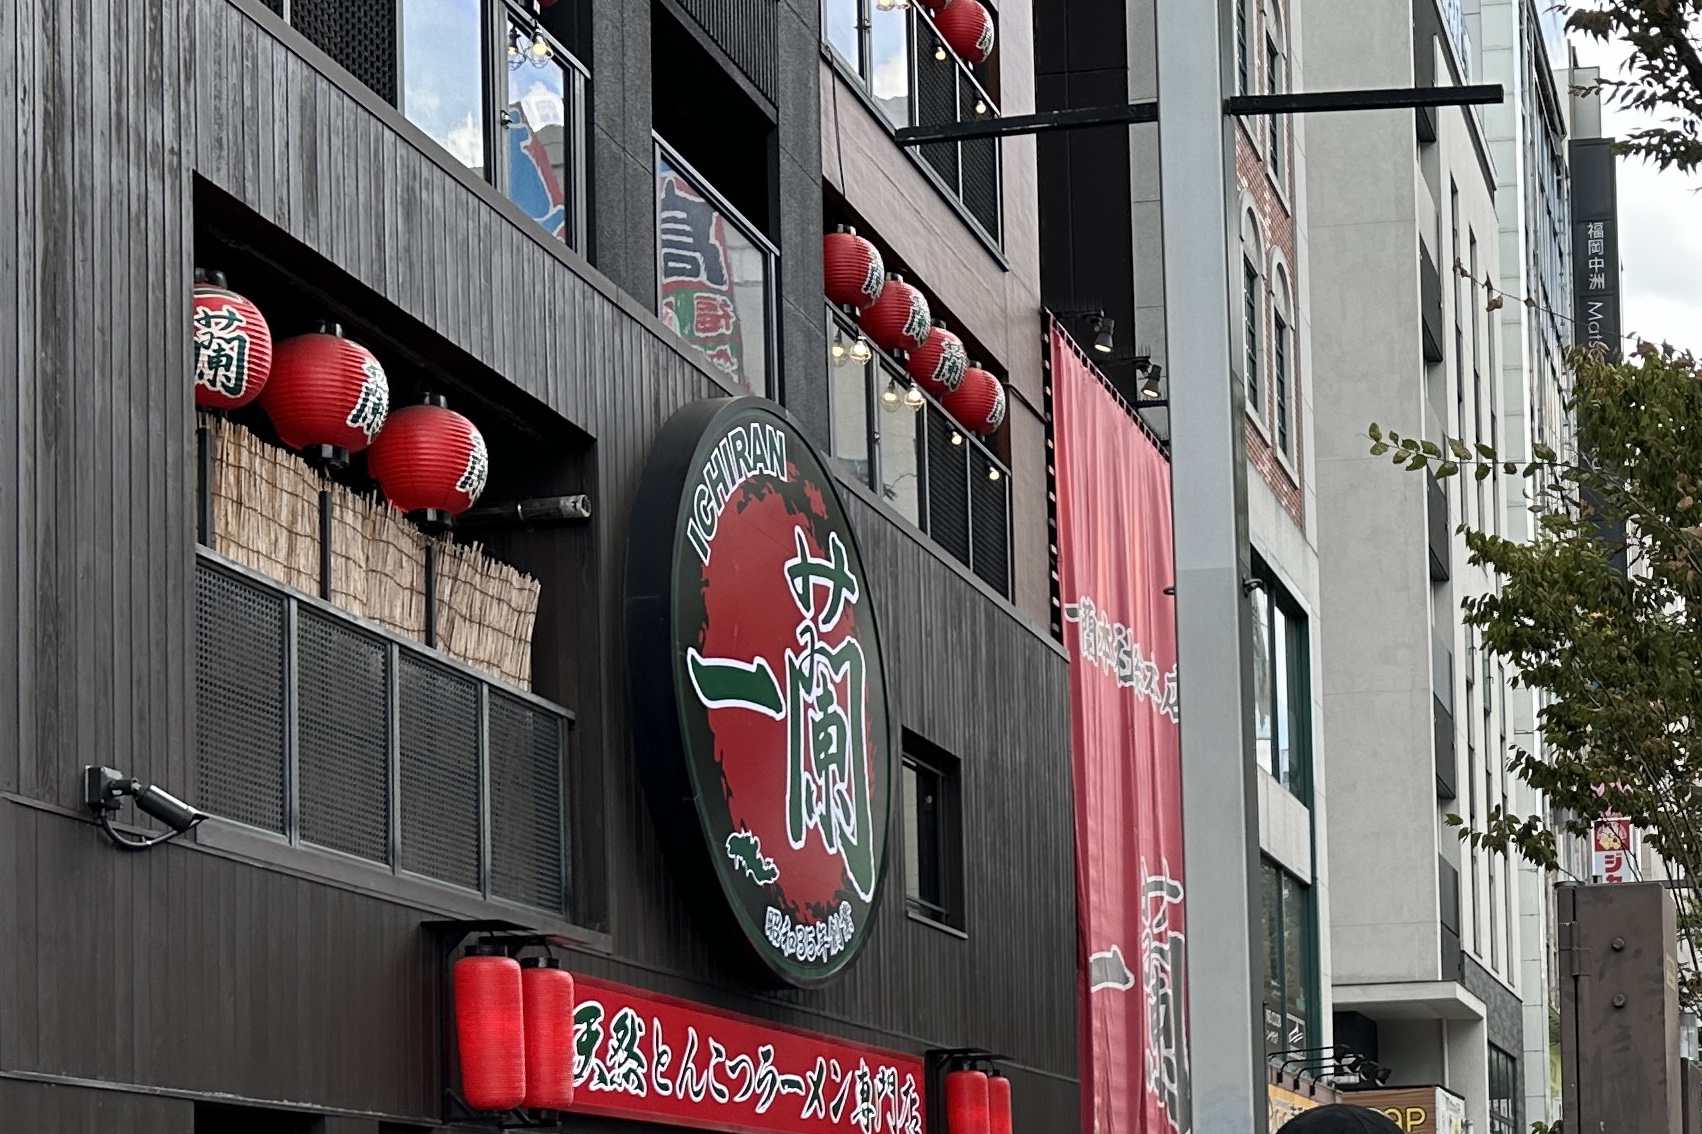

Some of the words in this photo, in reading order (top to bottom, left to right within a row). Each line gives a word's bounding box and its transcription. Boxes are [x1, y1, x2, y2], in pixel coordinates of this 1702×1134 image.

[1587, 222, 1605, 290] 福岡中洲
[1588, 301, 1604, 358] Mats
[686, 422, 787, 566] ICHIRAN
[687, 526, 875, 903] 一蘭
[764, 900, 855, 963] 昭和35年創業
